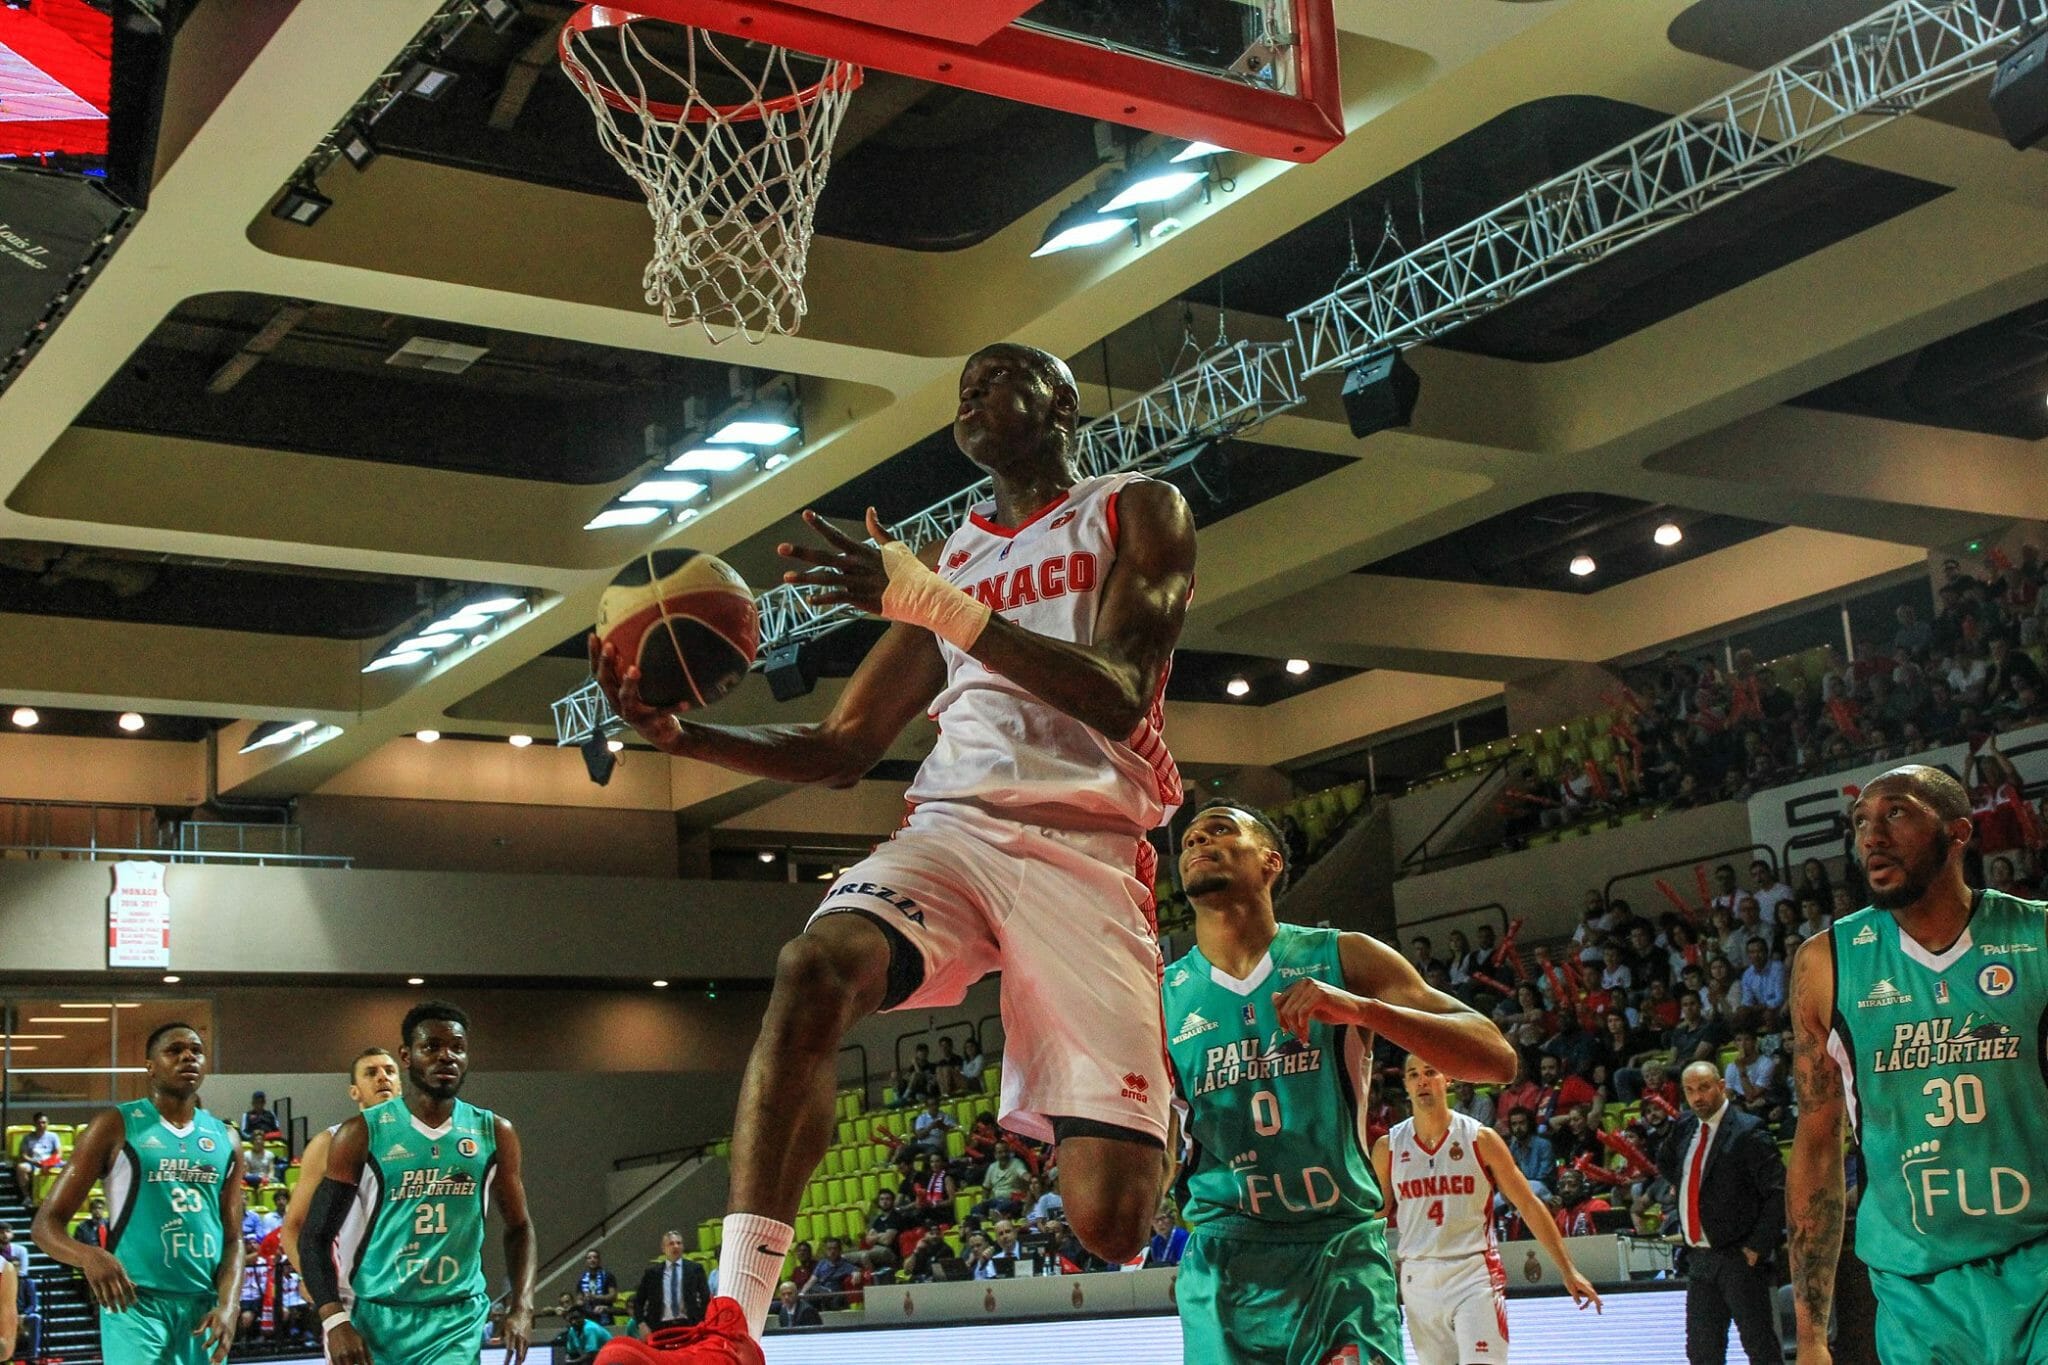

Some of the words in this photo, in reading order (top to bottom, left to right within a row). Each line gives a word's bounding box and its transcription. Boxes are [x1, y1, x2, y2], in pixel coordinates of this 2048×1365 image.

[960, 551, 1097, 613] NACO
[1852, 935, 1878, 945] PEAK
[1980, 944, 2010, 956] PAU
[1857, 995, 1912, 1008] MIRALUVER
[1894, 1017, 1953, 1049] PAU
[1207, 1037, 1260, 1070] PAU
[1874, 1036, 2020, 1073] LACO-ORTHEZ
[1194, 1049, 1321, 1097] LACO-ORTHEZ
[1121, 1088, 1148, 1104] errea
[1923, 1074, 1986, 1127] 30
[1250, 1090, 1282, 1137] 0
[148, 1170, 220, 1184] LACO-ORTHEZ
[159, 1159, 190, 1171] PAU
[402, 1168, 440, 1186] PAU
[172, 1188, 202, 1212] 23
[390, 1182, 477, 1201] LACO-ORTHEZ
[1246, 1167, 1340, 1214] FLD
[1397, 1175, 1474, 1200] MONACO
[1921, 1166, 2030, 1216] FLD
[415, 1203, 448, 1234] 21
[1427, 1199, 1444, 1226] 4
[172, 1233, 217, 1258] FLD
